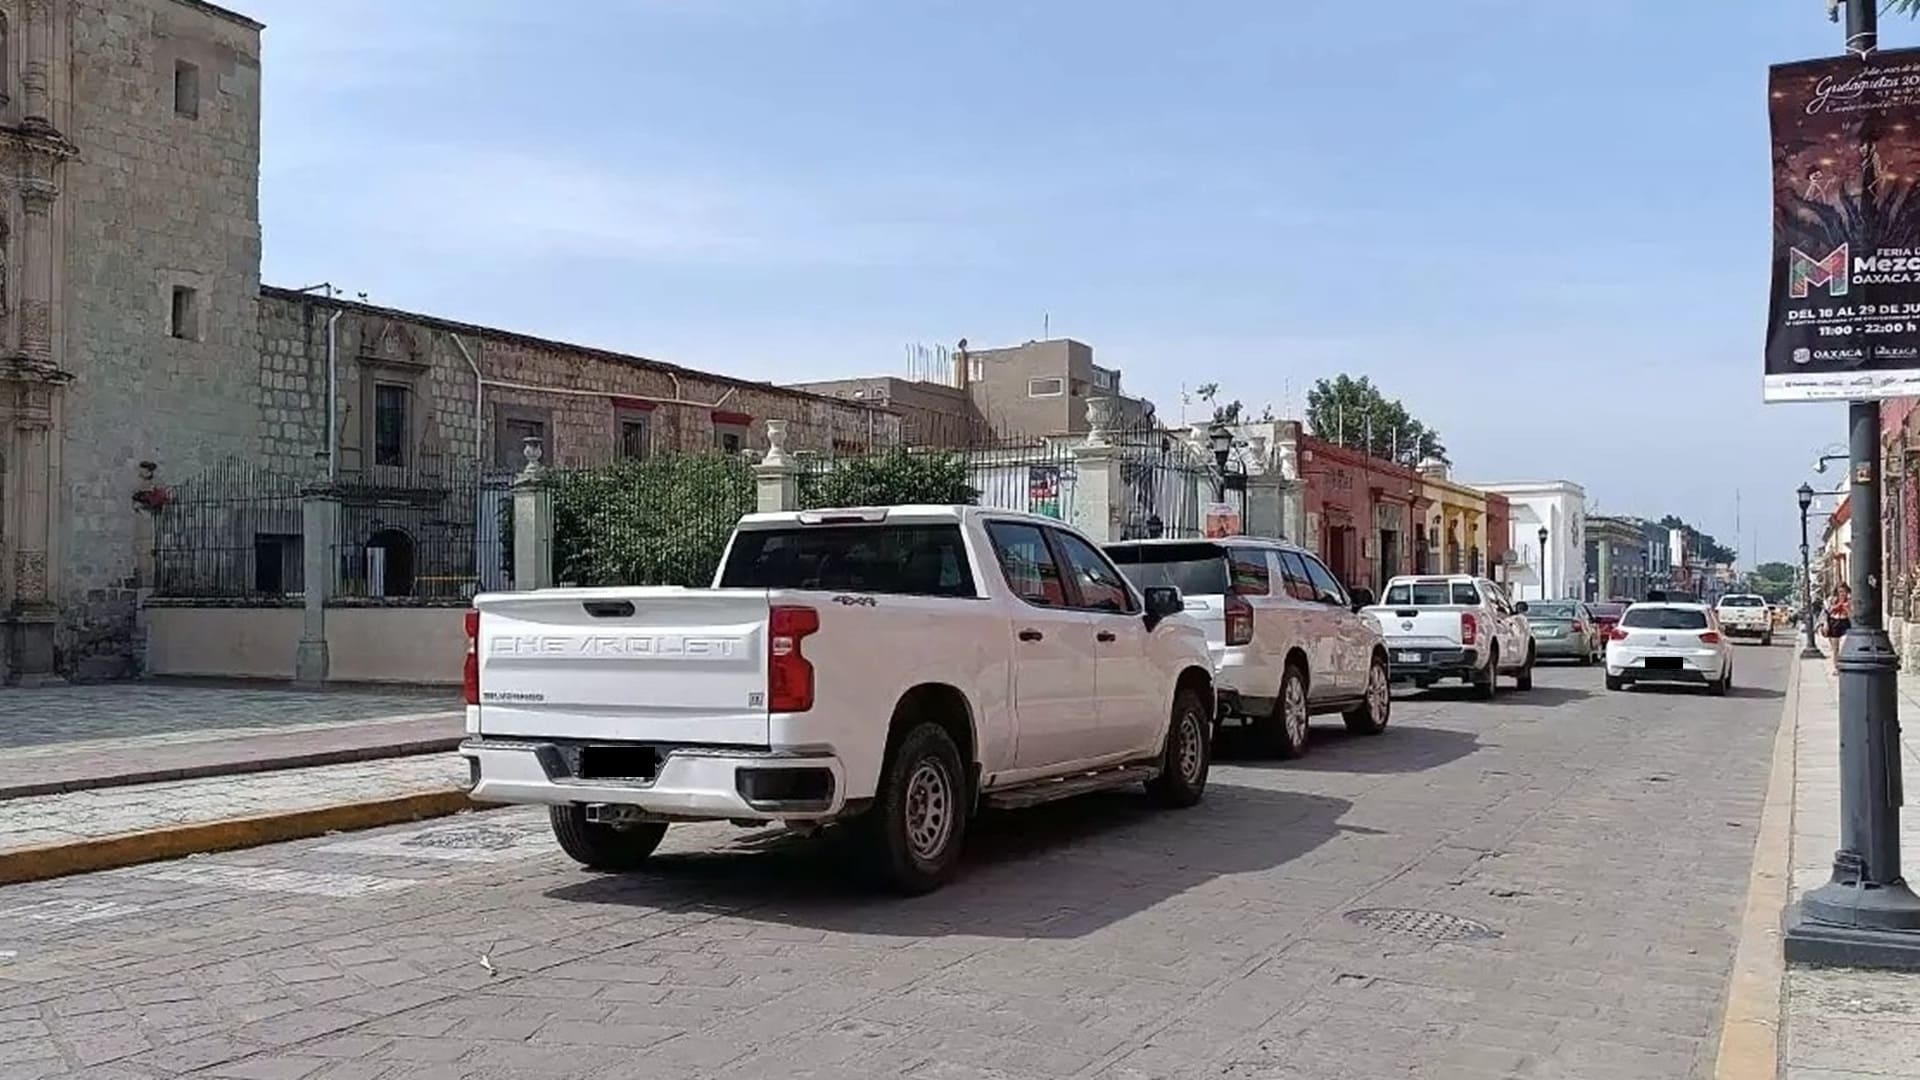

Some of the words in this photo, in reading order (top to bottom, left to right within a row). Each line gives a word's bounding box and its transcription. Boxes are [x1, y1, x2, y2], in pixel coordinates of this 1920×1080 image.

[1876, 247, 1911, 257] FERIA
[1852, 273, 1911, 285] OAXACA
[1788, 309, 1816, 320] DEL
[1818, 308, 1833, 318] 18
[1836, 306, 1856, 317] AL
[1859, 304, 1876, 315] 29
[1879, 304, 1899, 315] DE
[1819, 325, 1852, 336] 11:00
[1864, 322, 1903, 333] 22:00
[1906, 321, 1917, 332] h
[1813, 349, 1863, 360] OAXACA
[490, 636, 742, 657] CHEVROLET
